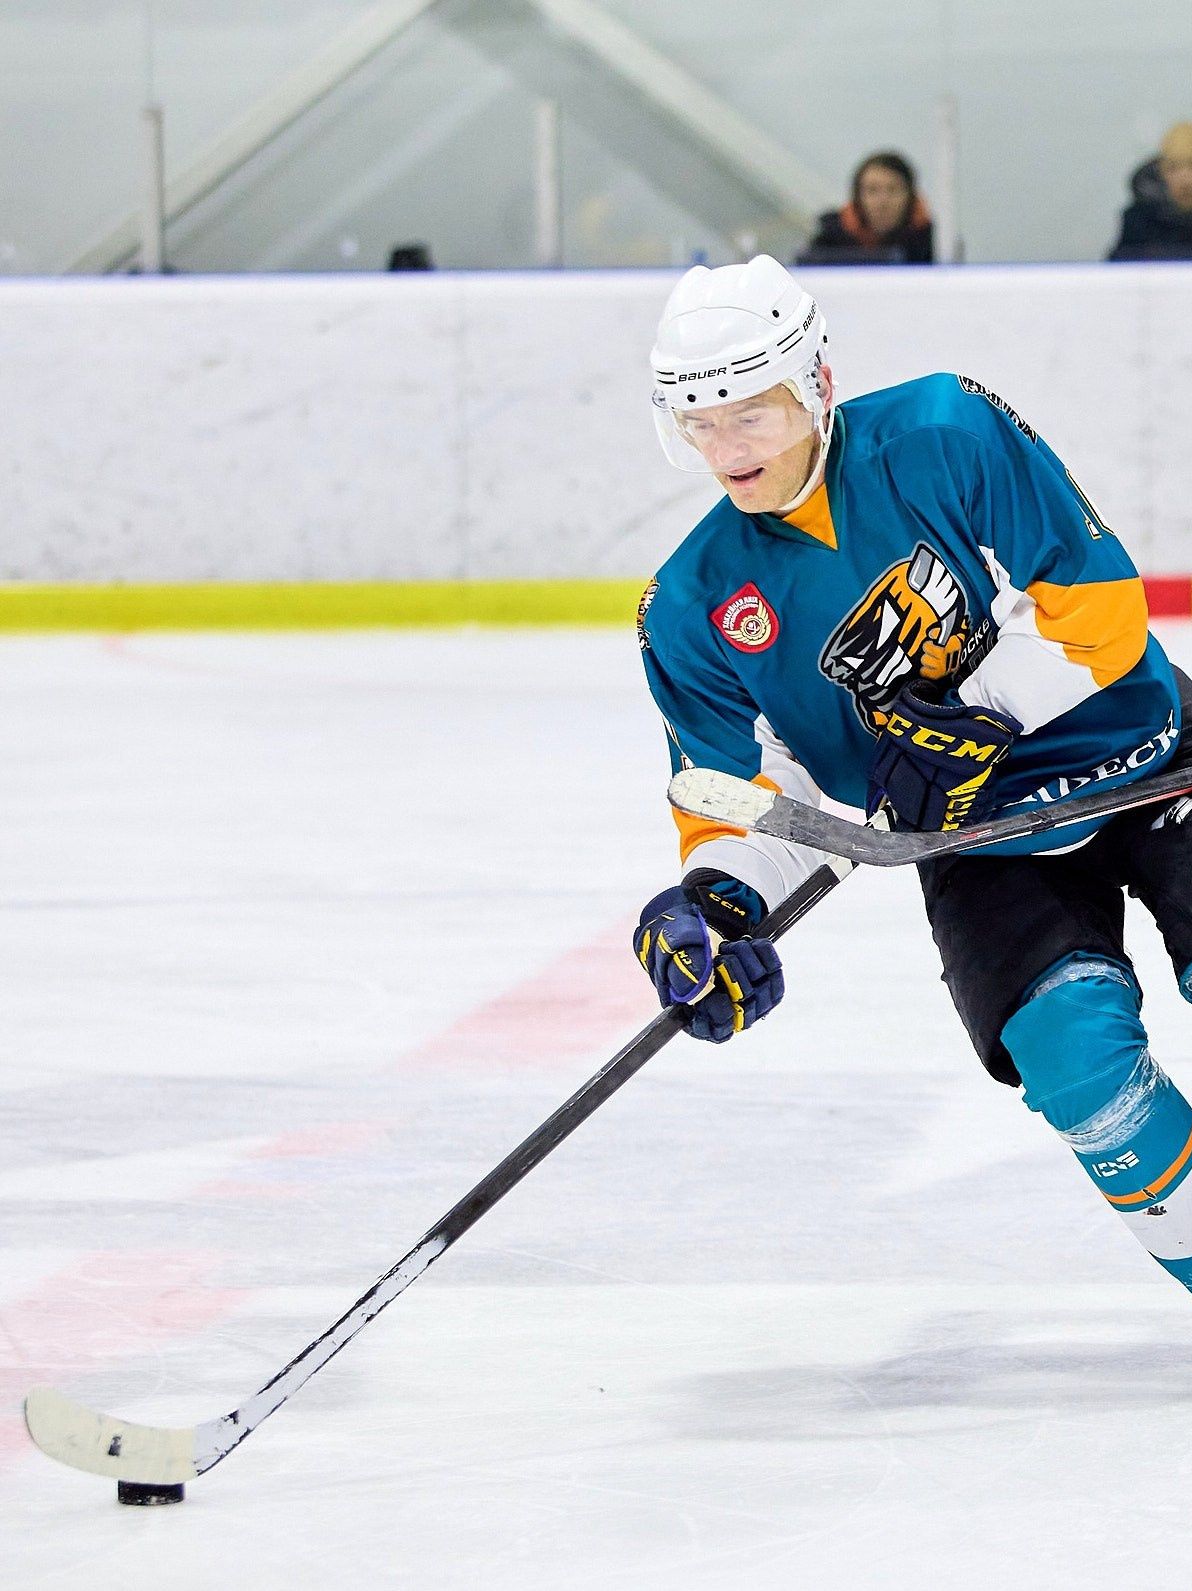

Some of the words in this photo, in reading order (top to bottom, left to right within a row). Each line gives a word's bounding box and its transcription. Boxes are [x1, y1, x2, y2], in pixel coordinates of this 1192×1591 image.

[678, 366, 727, 382] BAUER
[886, 712, 998, 762] CCM
[708, 892, 746, 917] CCM
